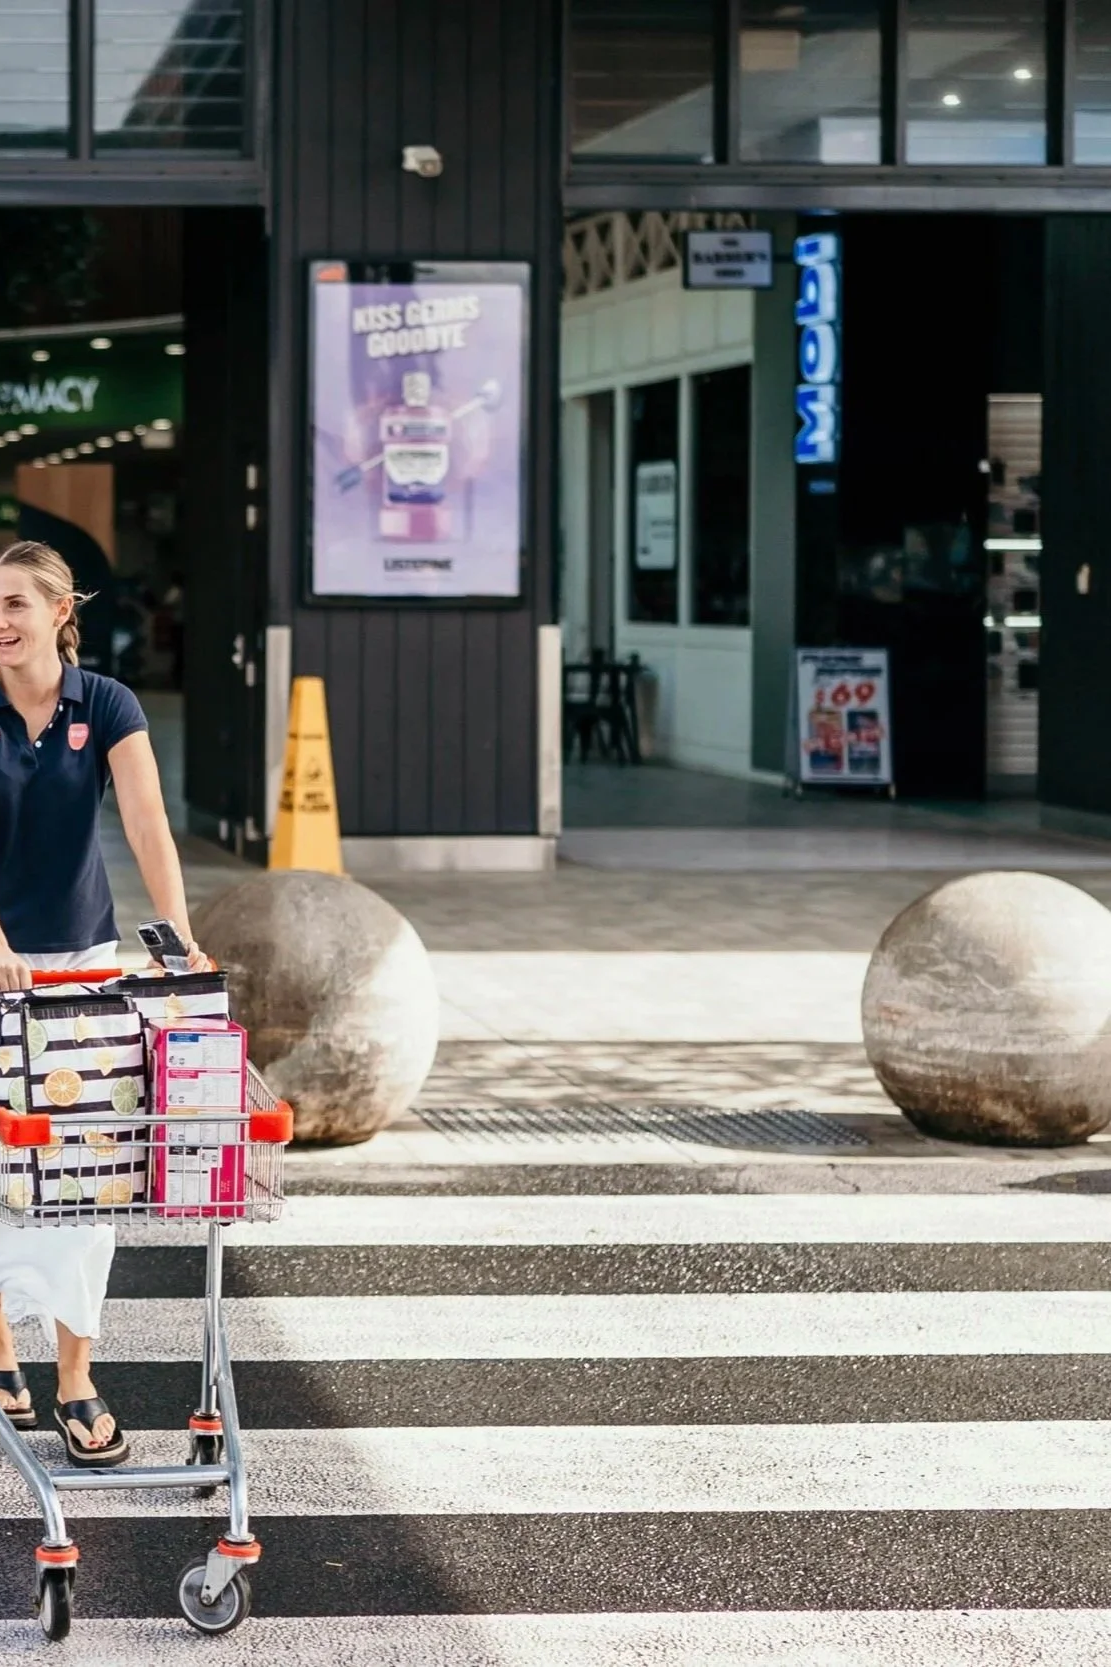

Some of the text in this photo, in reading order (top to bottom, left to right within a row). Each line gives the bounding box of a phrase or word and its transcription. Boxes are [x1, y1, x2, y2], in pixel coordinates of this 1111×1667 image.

[352, 295, 481, 333] KISS GERMS
[795, 234, 838, 463] Mobi
